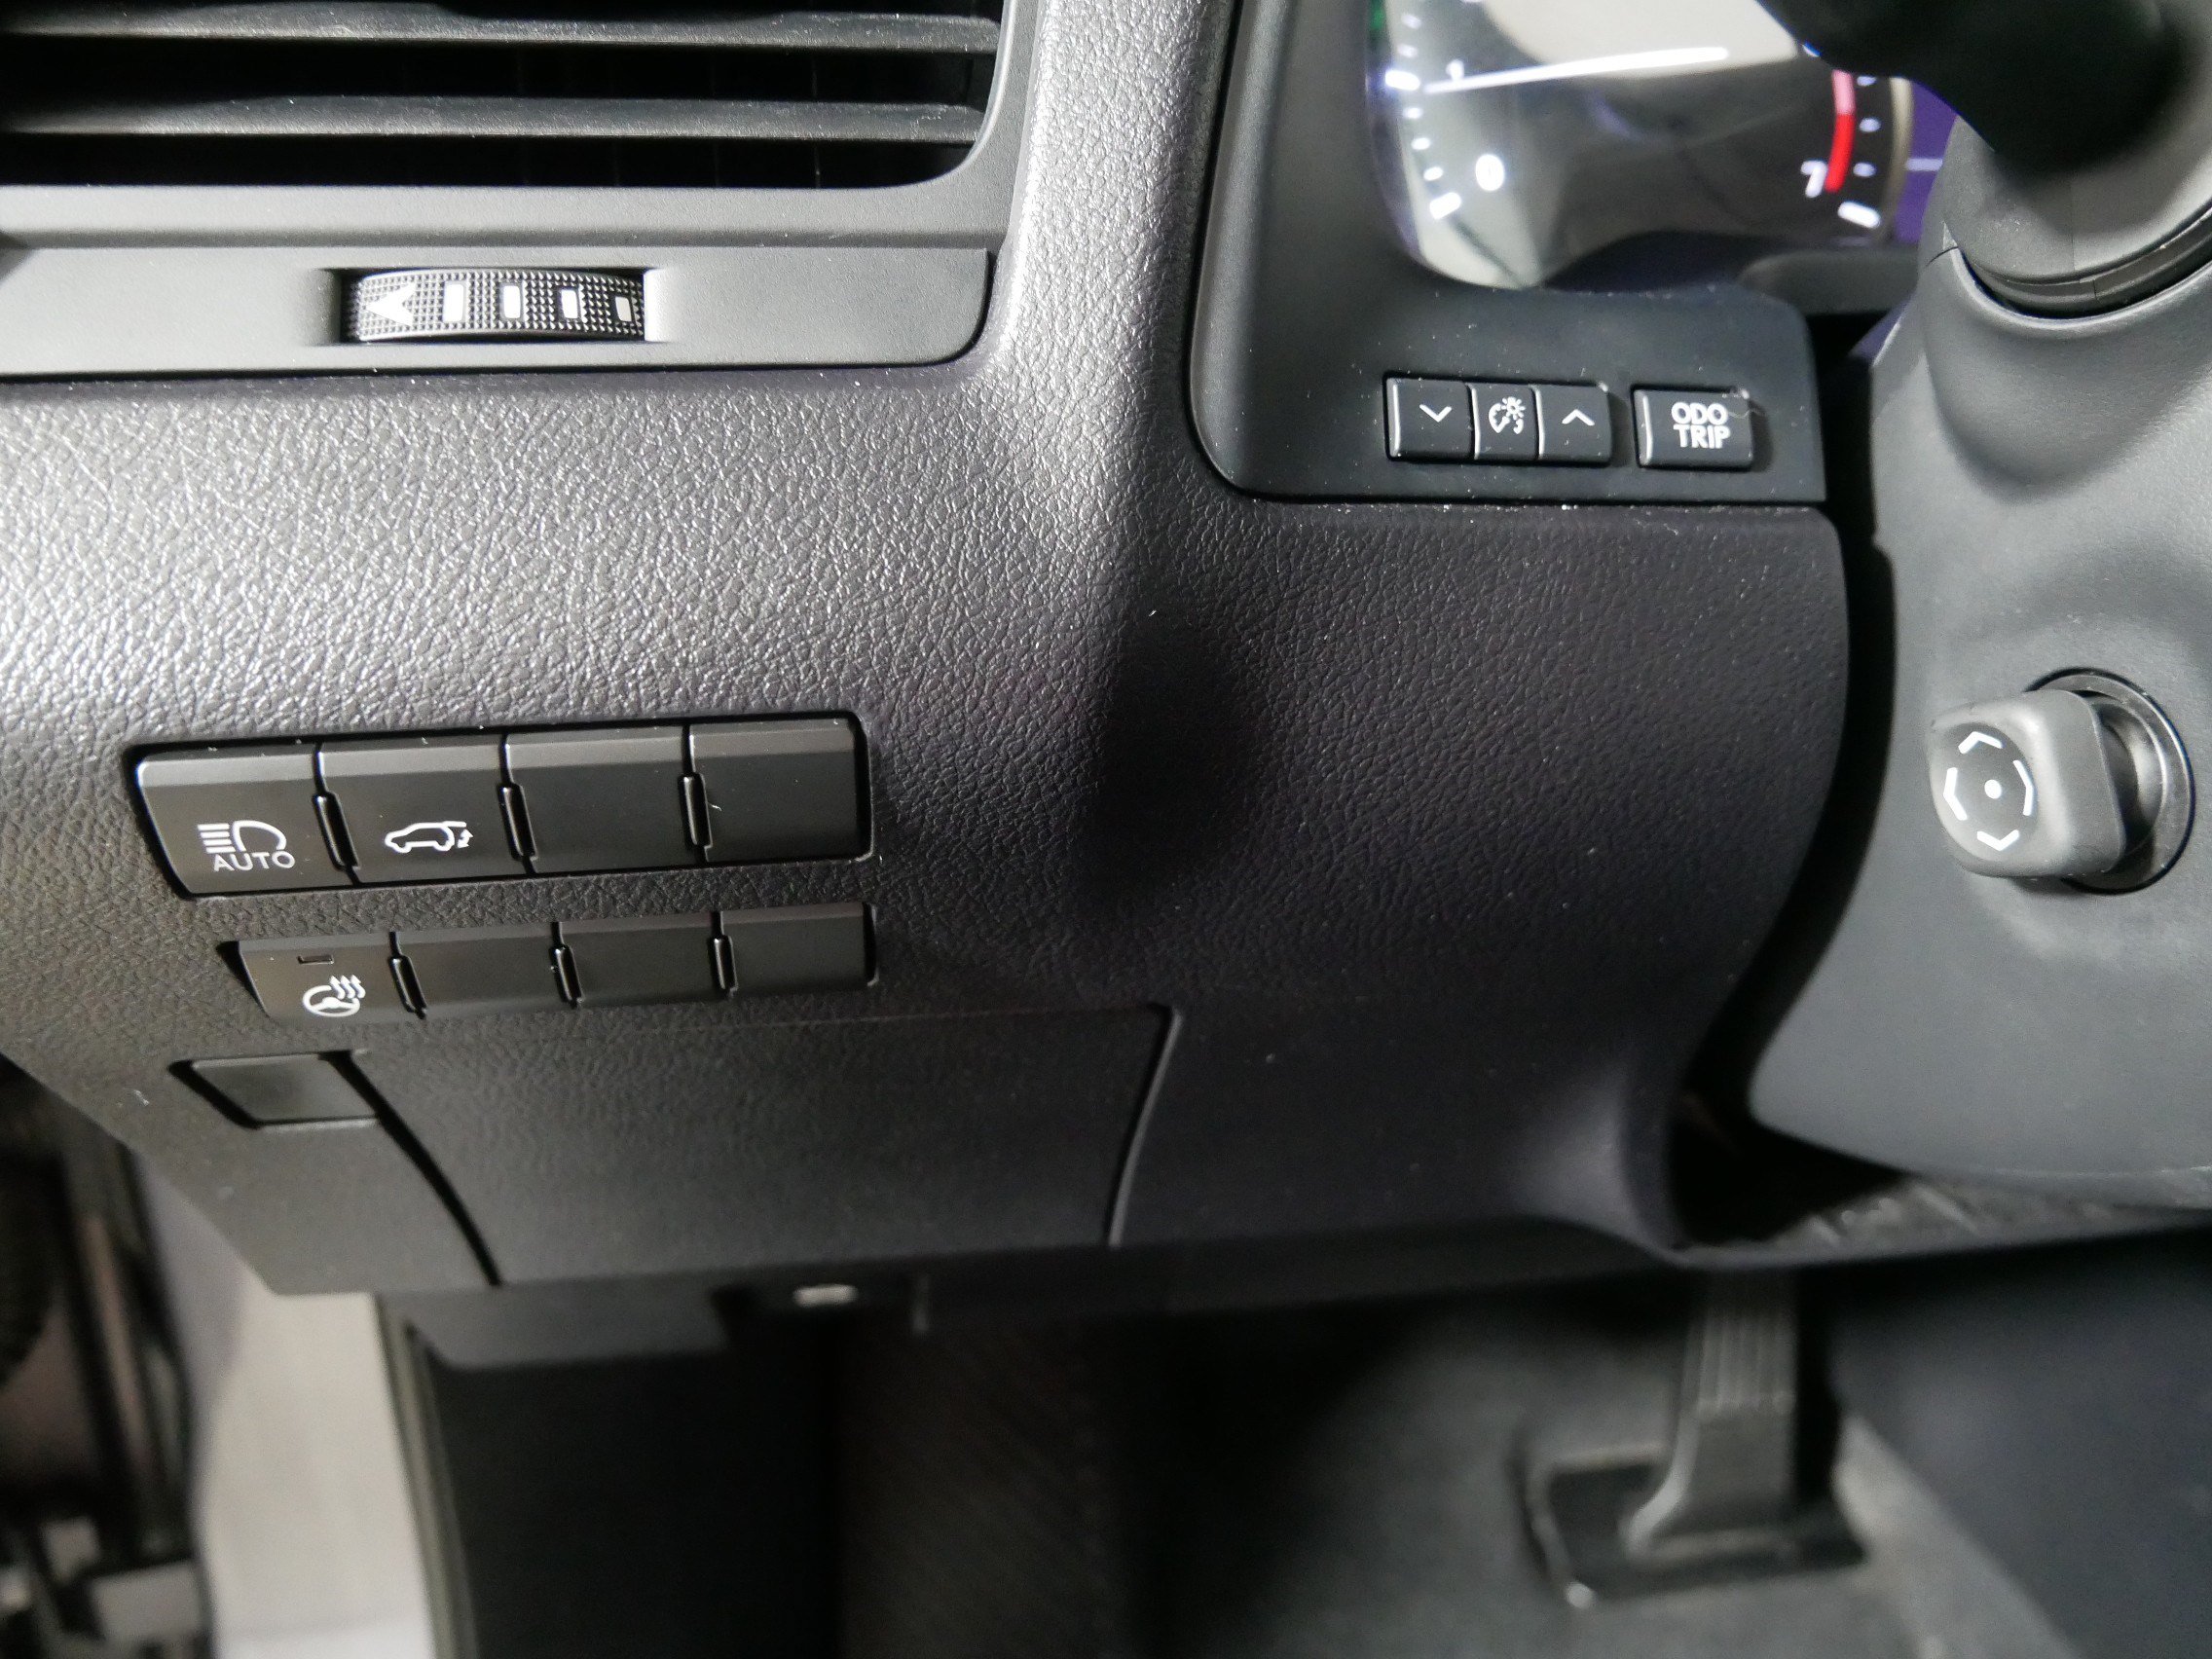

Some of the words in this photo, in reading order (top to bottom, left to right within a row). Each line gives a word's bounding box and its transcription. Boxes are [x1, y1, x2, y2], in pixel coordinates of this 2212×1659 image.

[1801, 161, 1826, 198] 7
[1672, 402, 1728, 424] ODO
[1675, 425, 1731, 449] TRIP
[214, 852, 295, 872] AUTO
